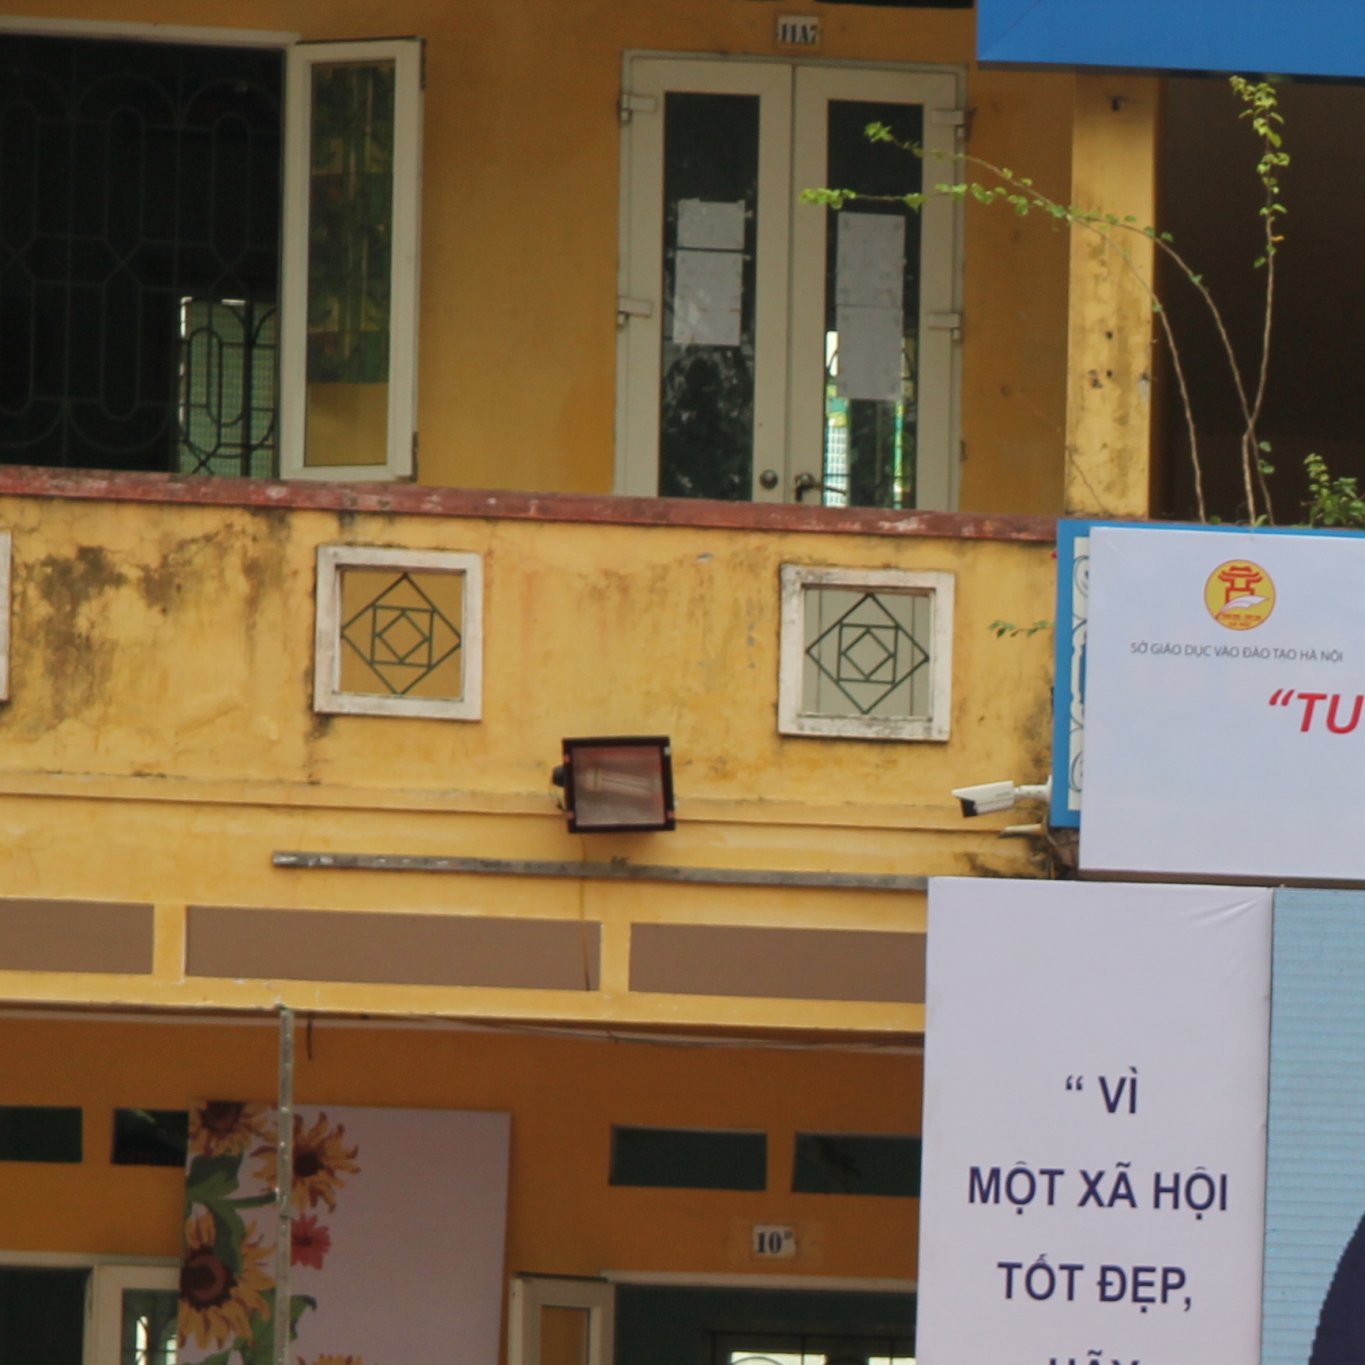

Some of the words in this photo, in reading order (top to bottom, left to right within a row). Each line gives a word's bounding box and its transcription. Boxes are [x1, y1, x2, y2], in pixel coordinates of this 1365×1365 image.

[1184, 643, 1212, 659] DỤC
[1099, 1067, 1137, 1114] VÌ
[969, 1161, 1064, 1215] MỘT
[1078, 1162, 1137, 1208] XÃ
[1154, 1166, 1227, 1220] HỘI
[997, 1254, 1084, 1301] TỐT
[1097, 1266, 1191, 1313] ĐẸP,
